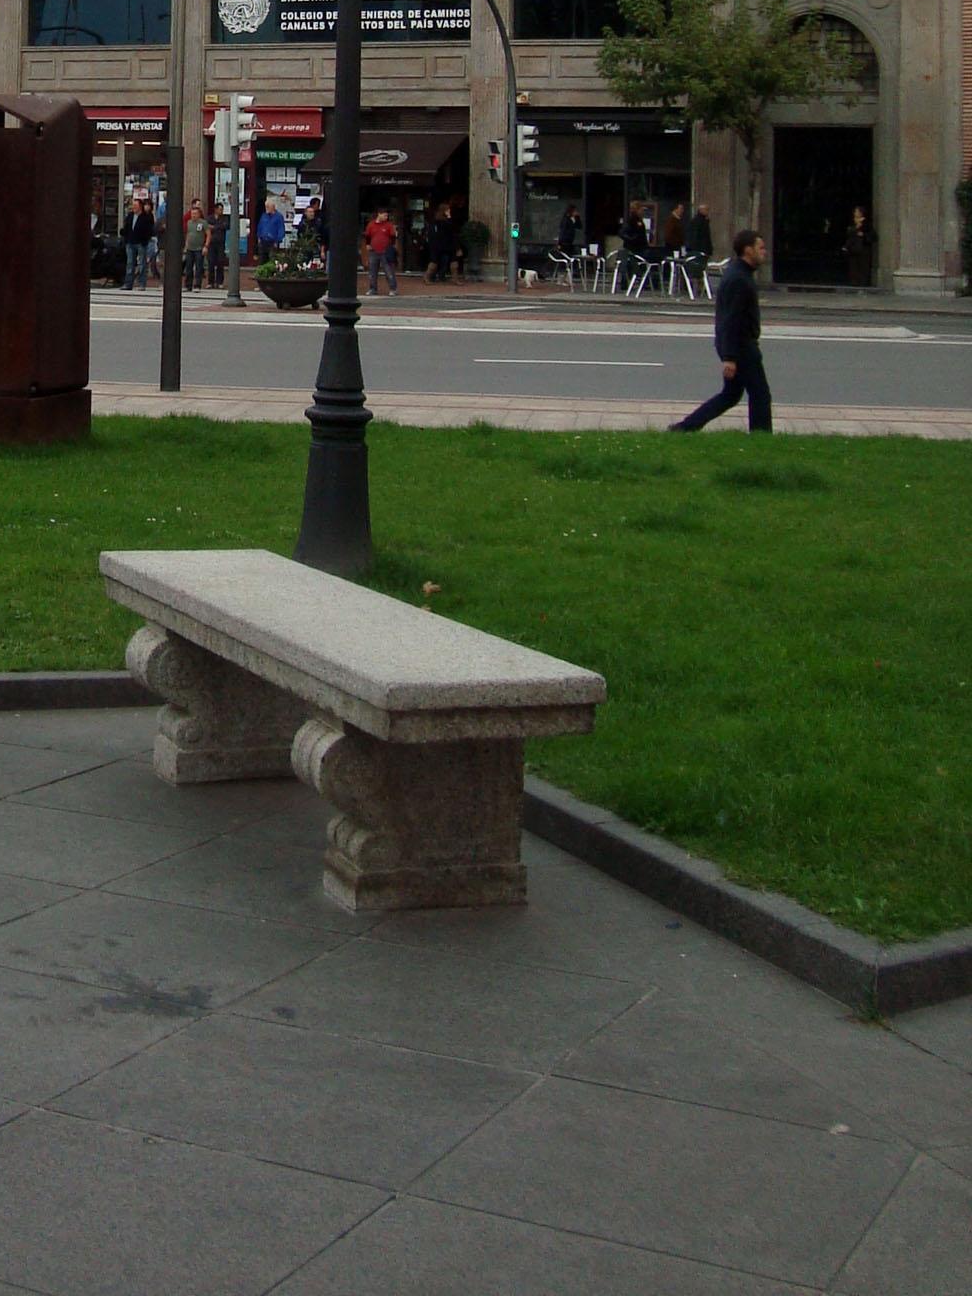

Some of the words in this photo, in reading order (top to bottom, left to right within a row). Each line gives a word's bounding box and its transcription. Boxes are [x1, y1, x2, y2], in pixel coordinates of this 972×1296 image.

[280, 11, 323, 21] COLEGIO
[326, 10, 339, 20] DE
[361, 10, 404, 20] ENIEROS
[408, 9, 421, 19] DE
[423, 8, 470, 19] CAMINOS
[280, 20, 325, 31] CANALES
[327, 21, 335, 30] Y
[387, 20, 406, 30] DEL
[410, 18, 433, 29] PAÍS
[436, 19, 471, 29] VASCO
[96, 121, 124, 131] PRENSA
[124, 122, 130, 131] Y
[130, 122, 163, 131] REVISTAS
[283, 124, 311, 132] europa
[256, 150, 278, 160] VENTA
[278, 151, 288, 160] DE
